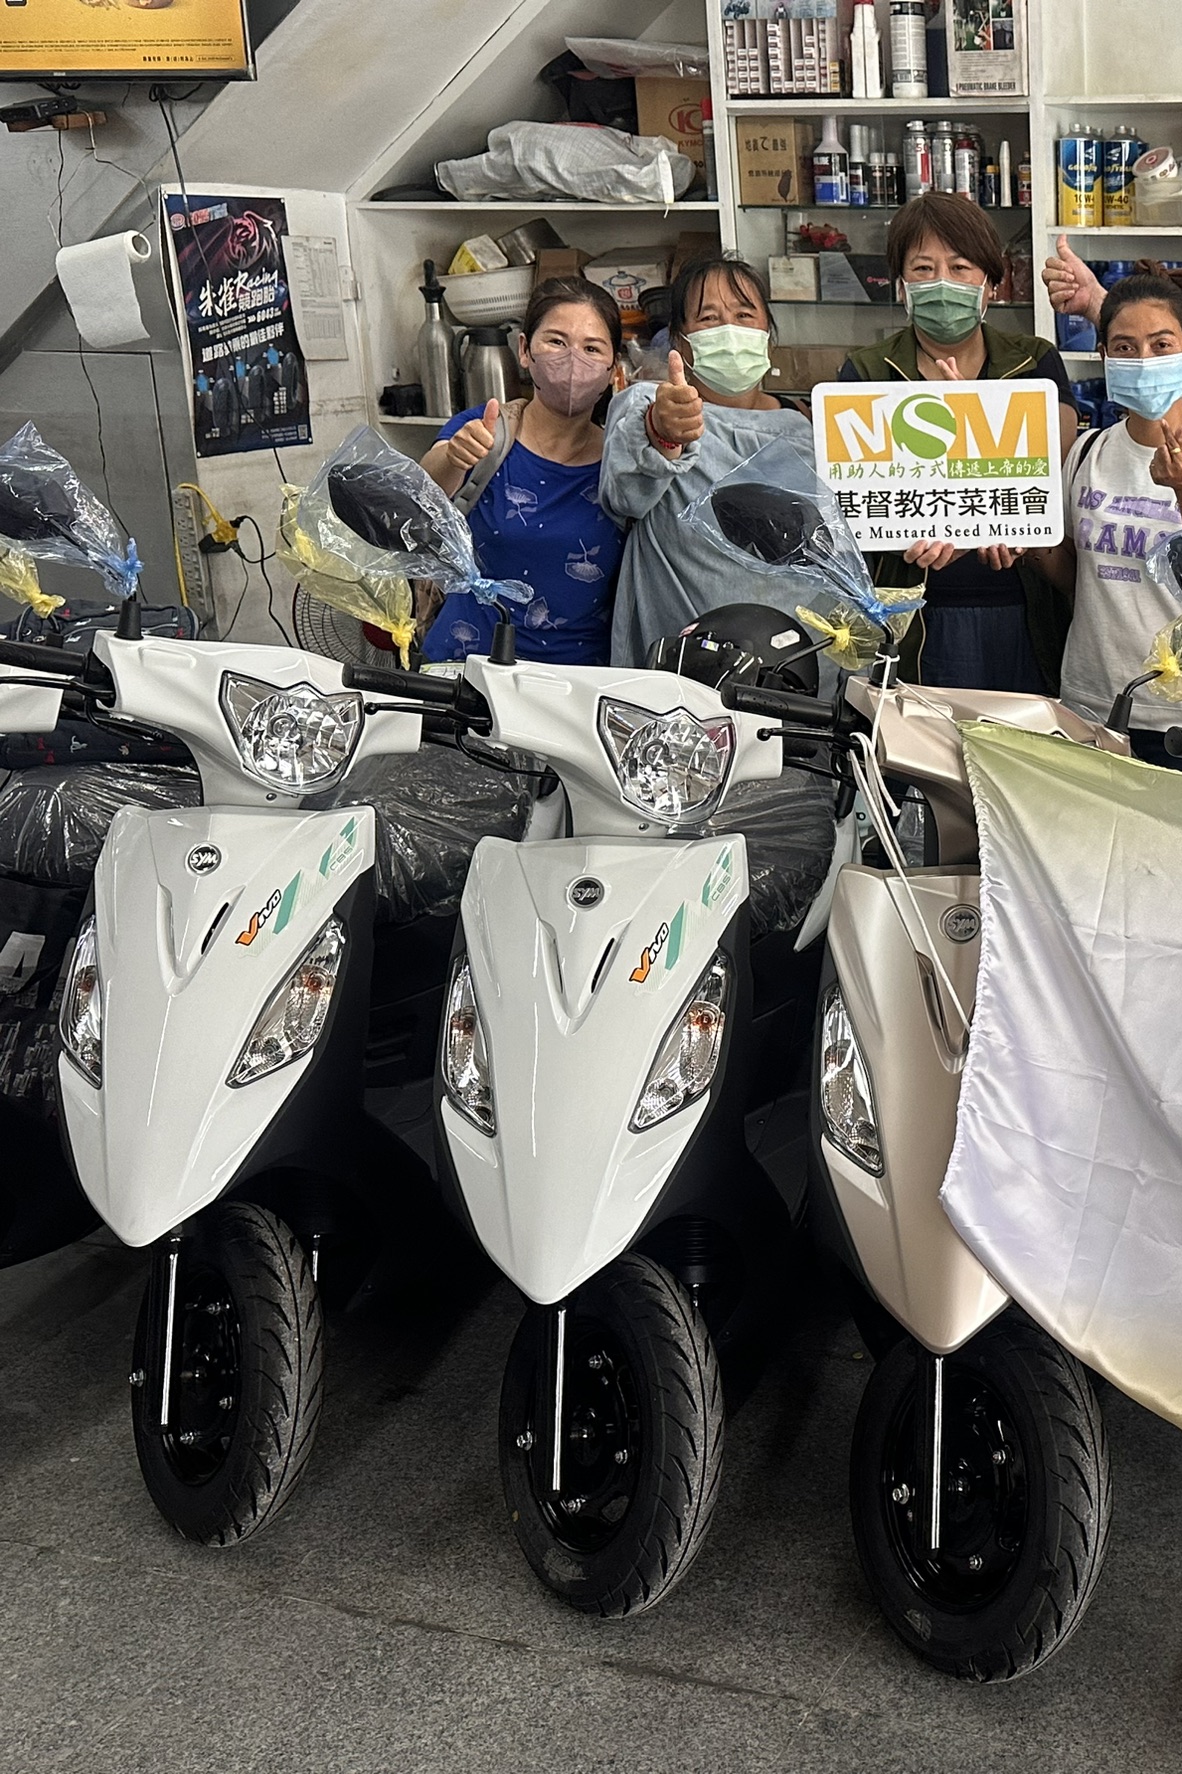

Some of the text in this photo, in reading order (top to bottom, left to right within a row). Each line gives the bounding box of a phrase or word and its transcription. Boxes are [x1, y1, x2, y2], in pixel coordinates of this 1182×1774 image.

[824, 391, 1049, 462] NSM
[829, 459, 1048, 481] 用助人的方式 傳遞上帝的愛
[835, 486, 1050, 520] 基督教芥菜種會
[869, 523, 937, 539] Mustard
[944, 524, 981, 538] Seed
[988, 523, 1053, 538] Mission
[189, 849, 219, 868] SYM
[572, 886, 601, 902] SYM
[711, 873, 731, 903] CBS
[949, 917, 976, 933] SYM
